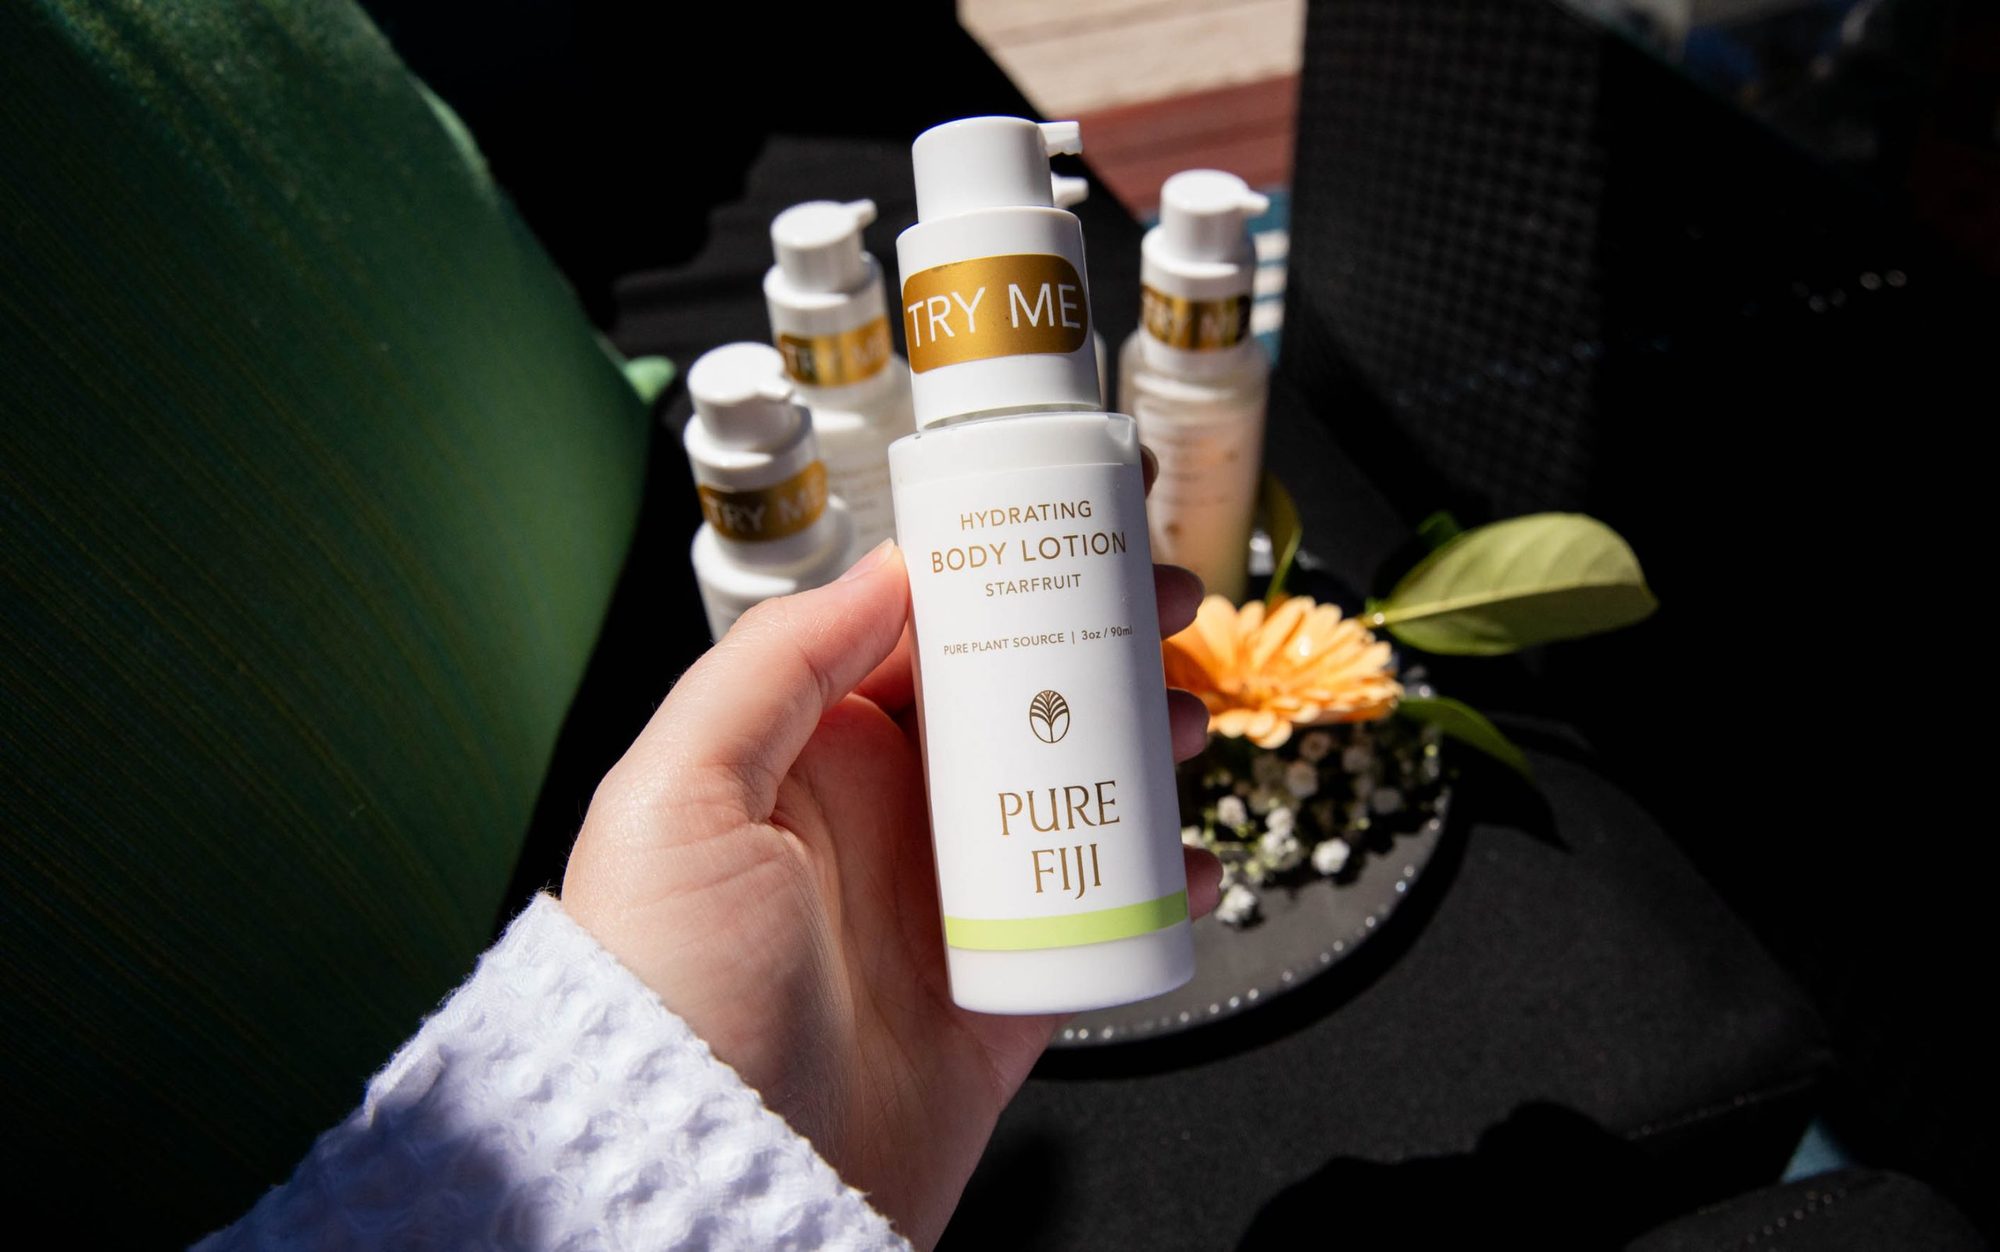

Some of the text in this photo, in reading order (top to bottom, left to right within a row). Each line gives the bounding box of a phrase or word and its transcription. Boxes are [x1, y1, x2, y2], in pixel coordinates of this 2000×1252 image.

[907, 283, 1080, 347] TRY ME
[960, 500, 1092, 531] HYDRATING
[931, 531, 1127, 574] BODY LOTION
[985, 573, 1082, 597] STARFRUIT
[943, 643, 968, 656] PURE
[971, 638, 1009, 652] PLANT
[1013, 632, 1065, 648] SOURCE
[1081, 630, 1101, 641] 3oz
[1110, 625, 1133, 638] 90ml
[998, 780, 1120, 836] PURE
[1031, 843, 1102, 900] FIJI
